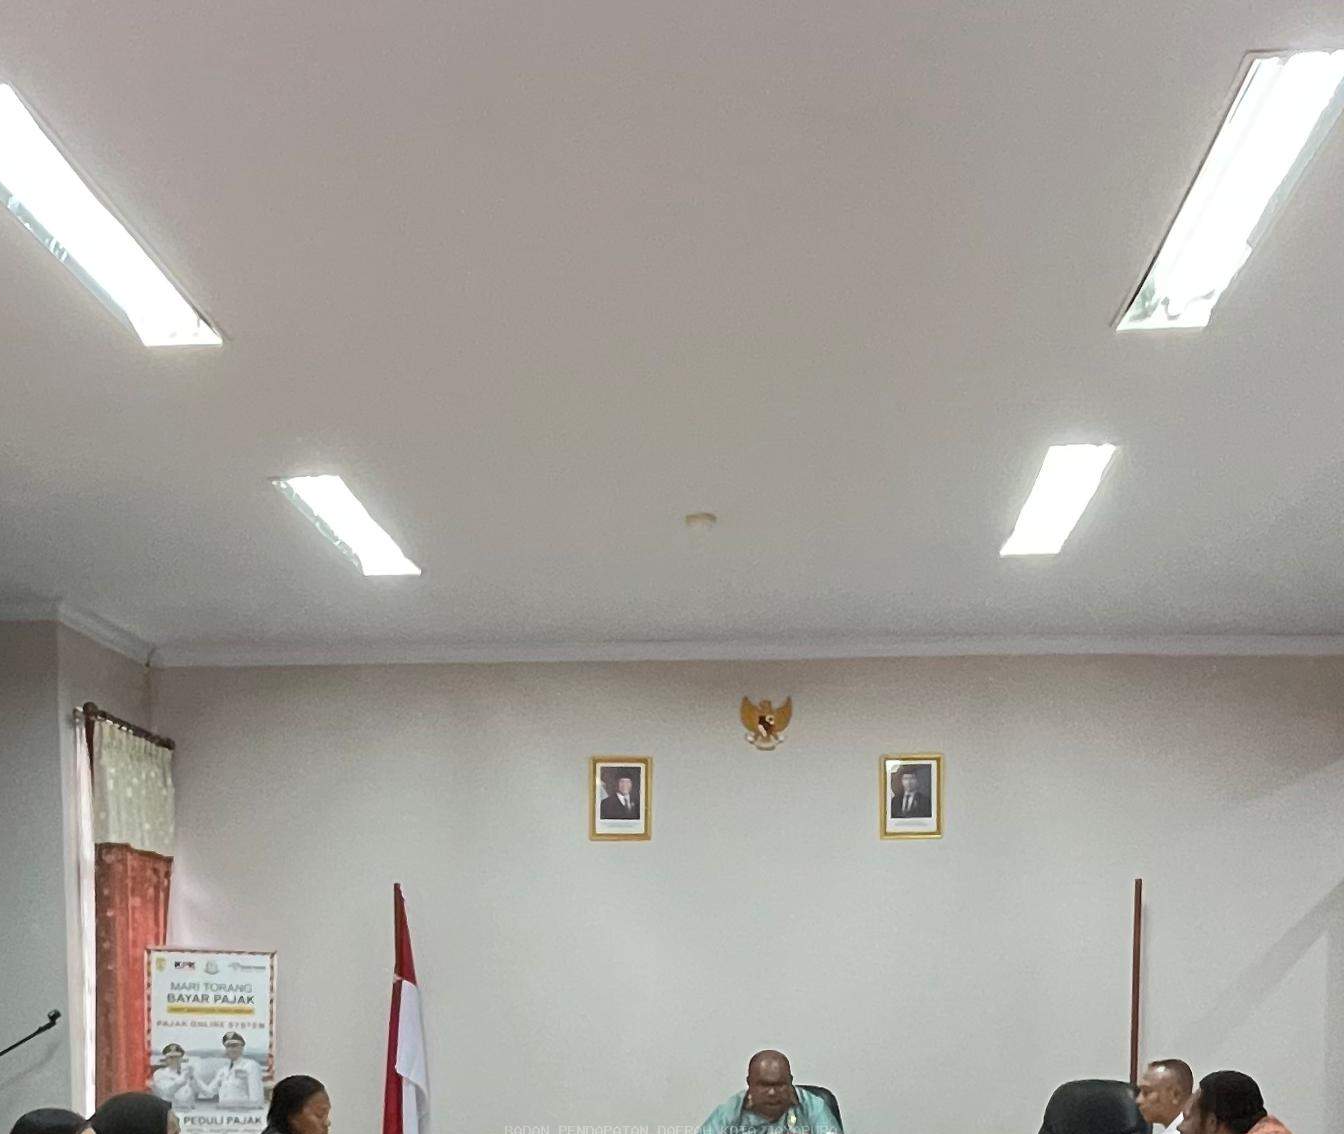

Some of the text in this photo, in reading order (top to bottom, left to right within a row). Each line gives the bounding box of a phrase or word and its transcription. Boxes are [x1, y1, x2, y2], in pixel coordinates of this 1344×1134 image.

[174, 961, 196, 970] KPK
[170, 982, 253, 993] MARI TORANG
[167, 993, 255, 1005] BAYAR PAJAK
[156, 1020, 188, 1028] PAJAK
[190, 1020, 225, 1028] ONLINE
[183, 1116, 224, 1126] PEDULI
[226, 1116, 262, 1126] PAJAK
